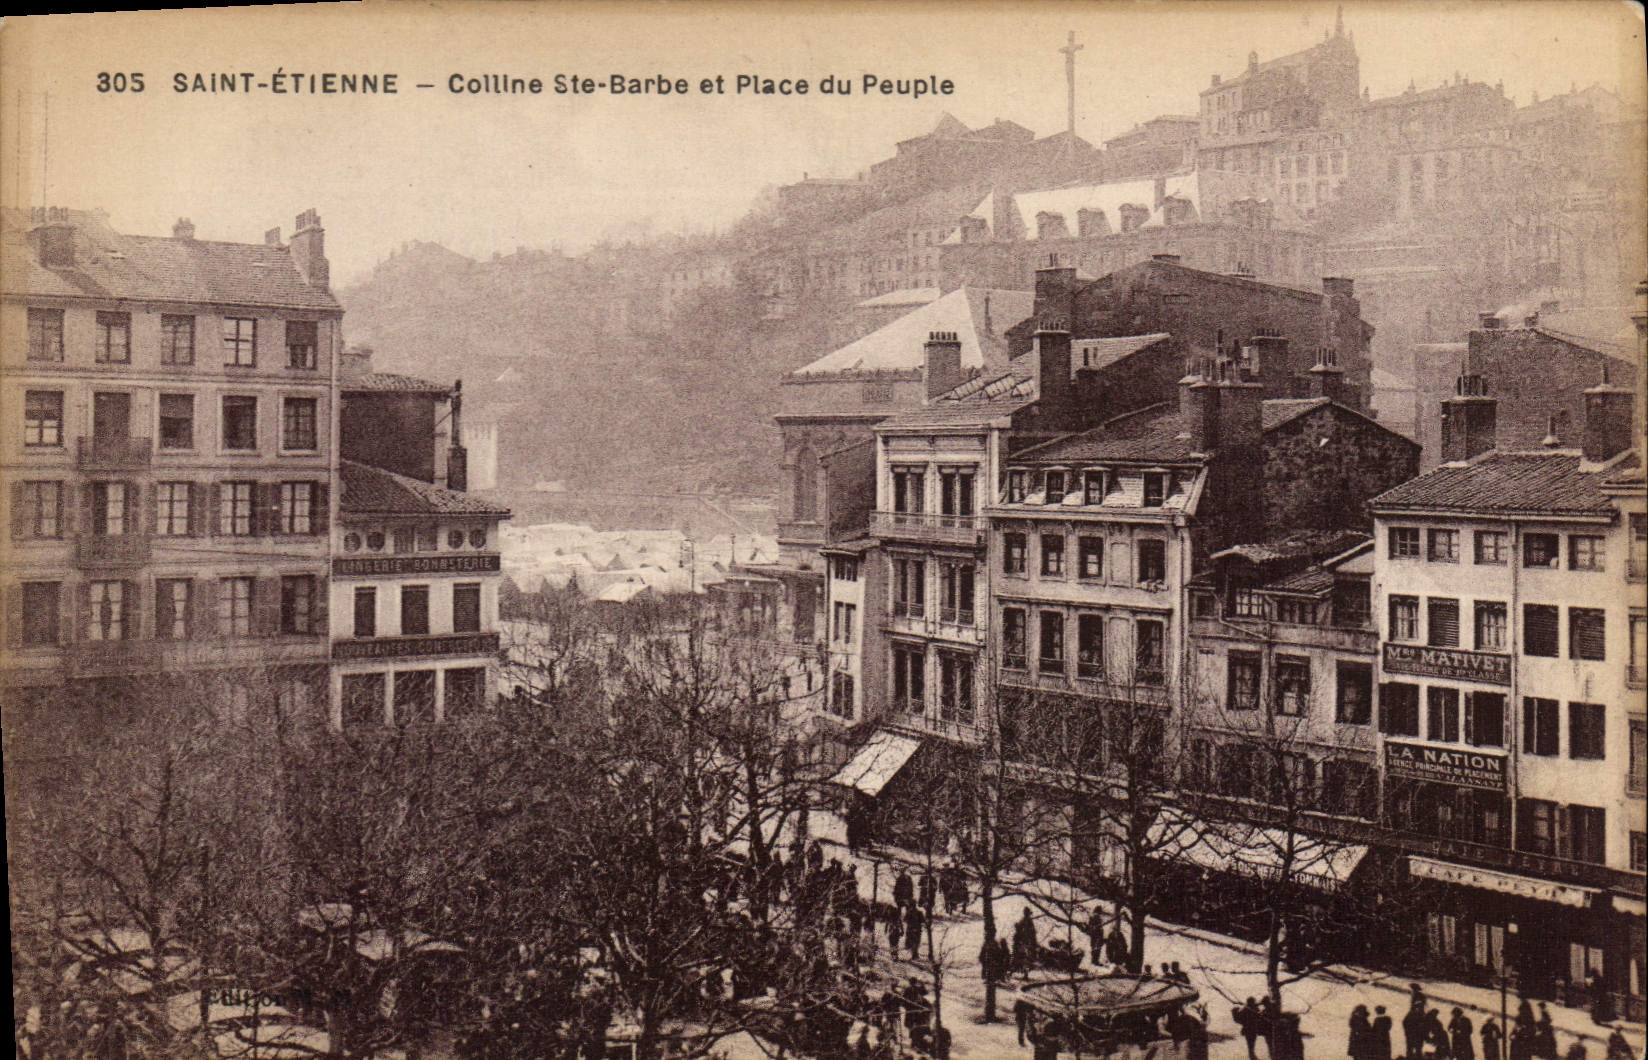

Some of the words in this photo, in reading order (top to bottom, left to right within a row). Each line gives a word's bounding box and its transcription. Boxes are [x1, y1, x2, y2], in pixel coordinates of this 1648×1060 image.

[342, 559, 401, 573] LINGERIE
[1421, 650, 1508, 672] MATIVET
[1387, 745, 1414, 759] LA
[1424, 749, 1500, 771] NATION
